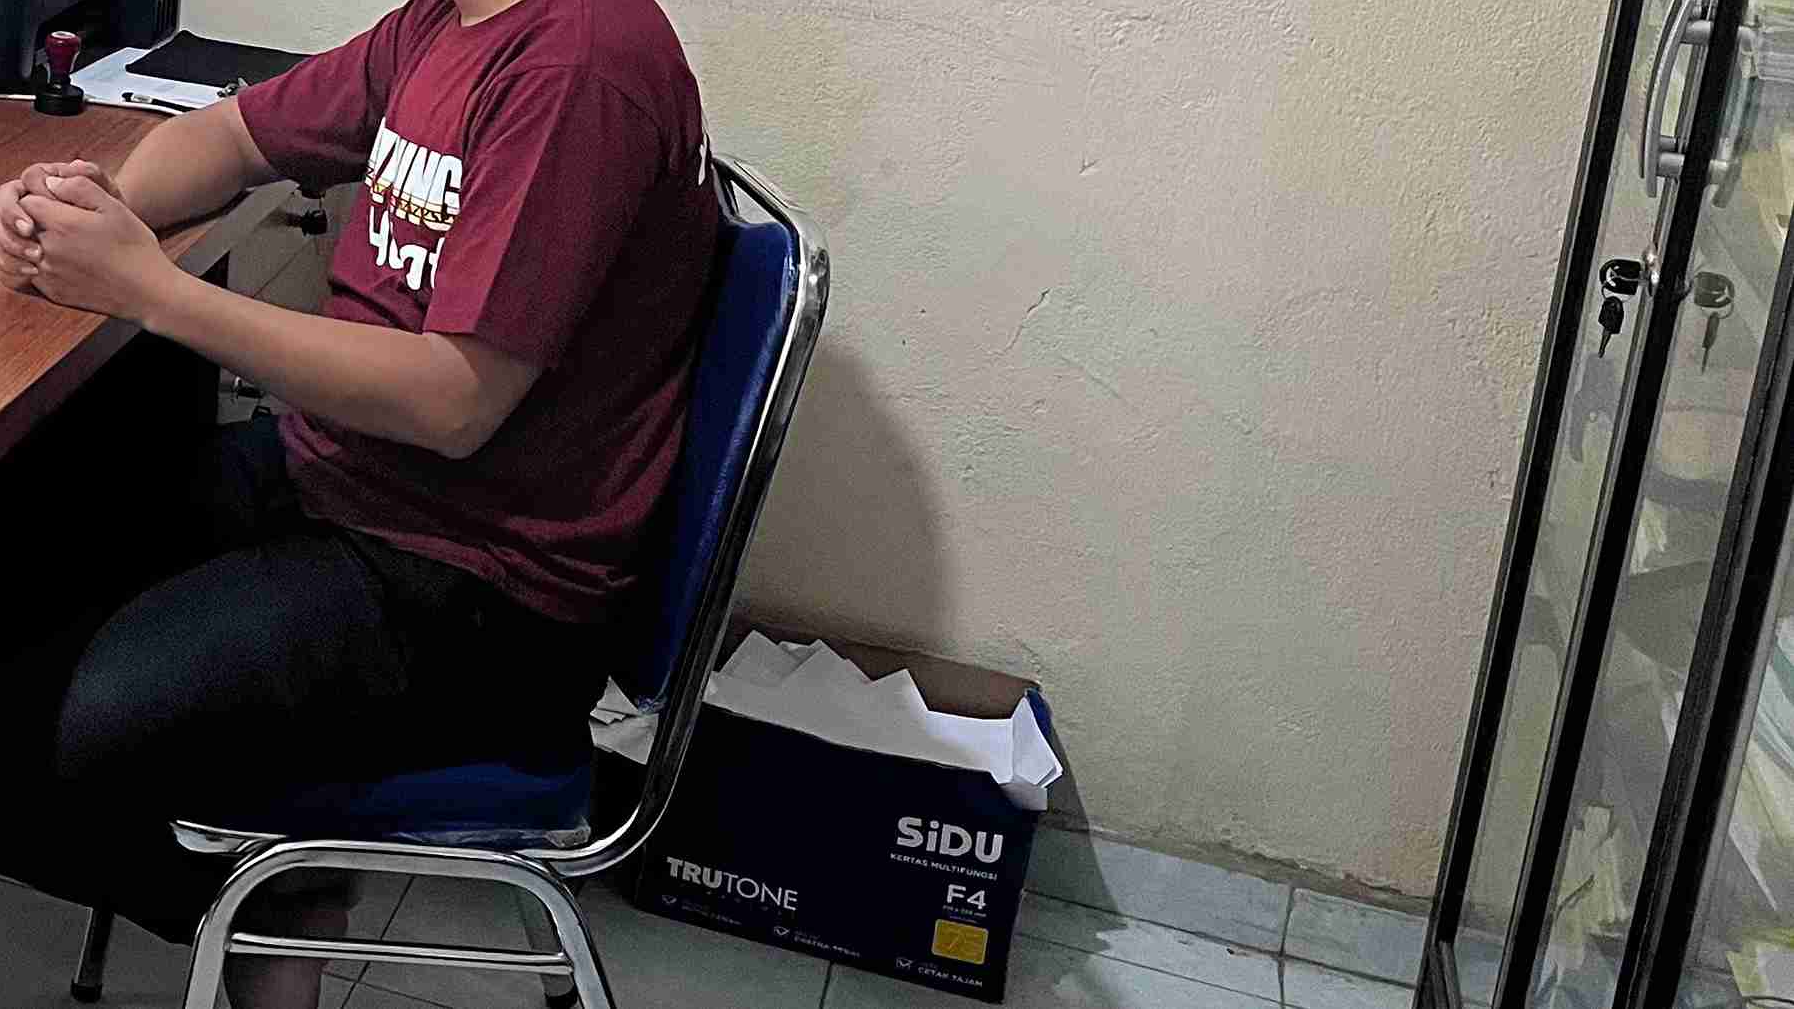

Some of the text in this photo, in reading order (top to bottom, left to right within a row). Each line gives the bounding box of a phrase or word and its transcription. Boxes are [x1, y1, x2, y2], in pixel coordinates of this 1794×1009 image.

[896, 816, 1004, 864] SiDU
[666, 855, 799, 912] TRUTONE
[890, 852, 999, 881] KERTAS MULTIFUNGSI
[946, 883, 987, 910] F4
